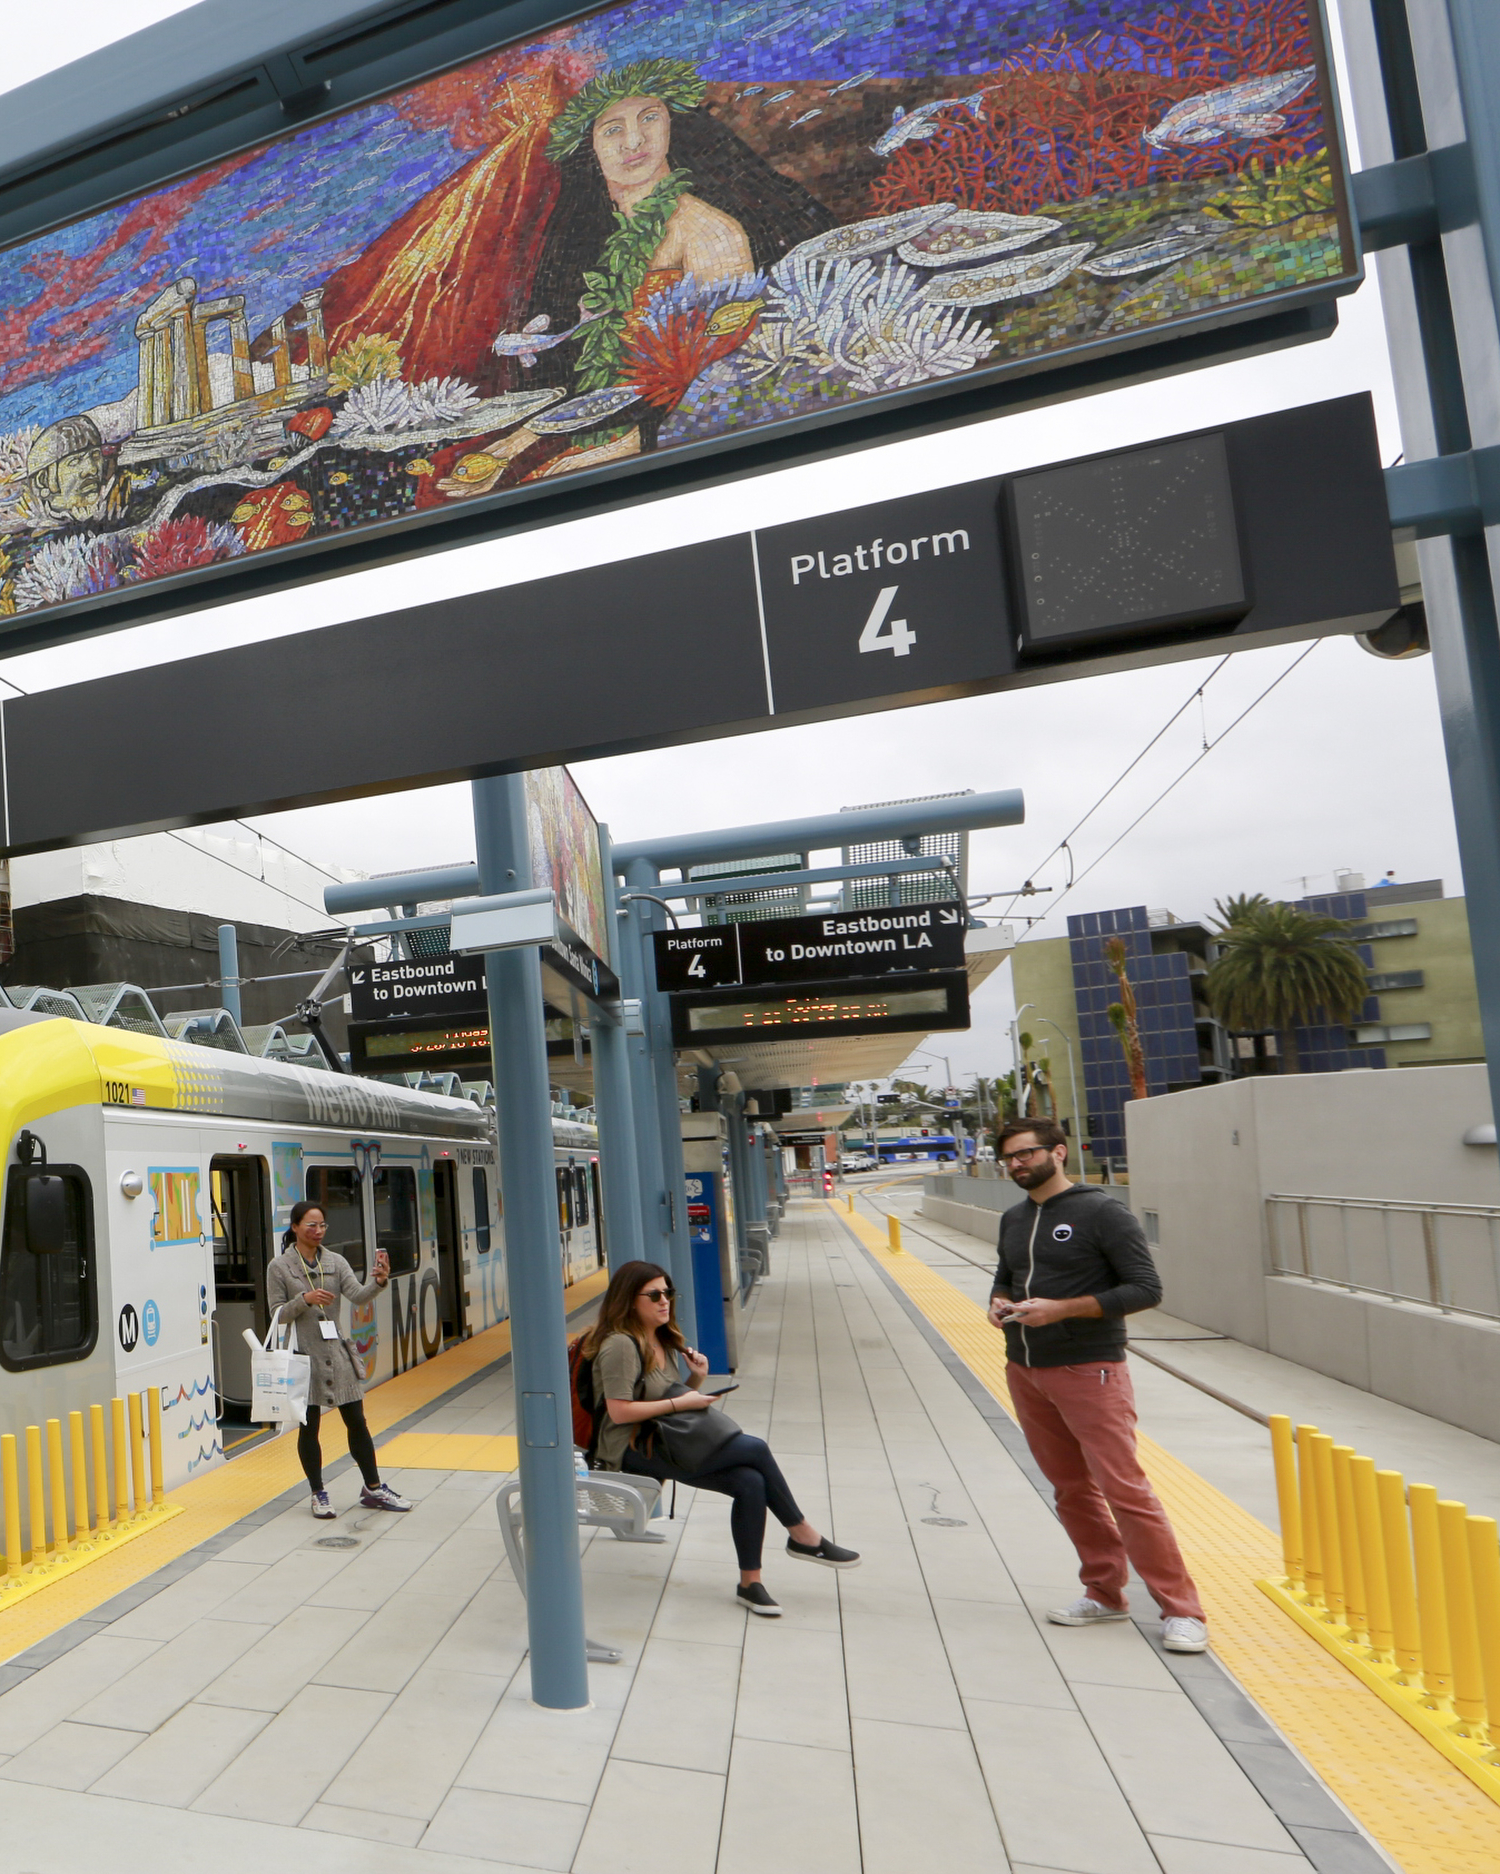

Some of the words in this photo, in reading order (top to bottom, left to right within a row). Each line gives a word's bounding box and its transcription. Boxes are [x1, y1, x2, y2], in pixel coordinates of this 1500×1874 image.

[790, 529, 970, 585] Platform
[858, 585, 917, 657] 4
[822, 911, 931, 937] Eastbound
[667, 936, 723, 951] Platform
[765, 947, 785, 962] to
[791, 934, 896, 961] Downtown
[903, 932, 933, 950] LA
[371, 961, 455, 982] Eastbound
[687, 954, 706, 978] 4
[373, 988, 388, 1000] to
[393, 980, 477, 998] Downtown
[482, 976, 488, 989] L
[105, 1081, 130, 1104] 1021
[289, 1065, 367, 1126] Metro
[355, 1078, 401, 1128] Rail
[121, 1312, 136, 1345] M
